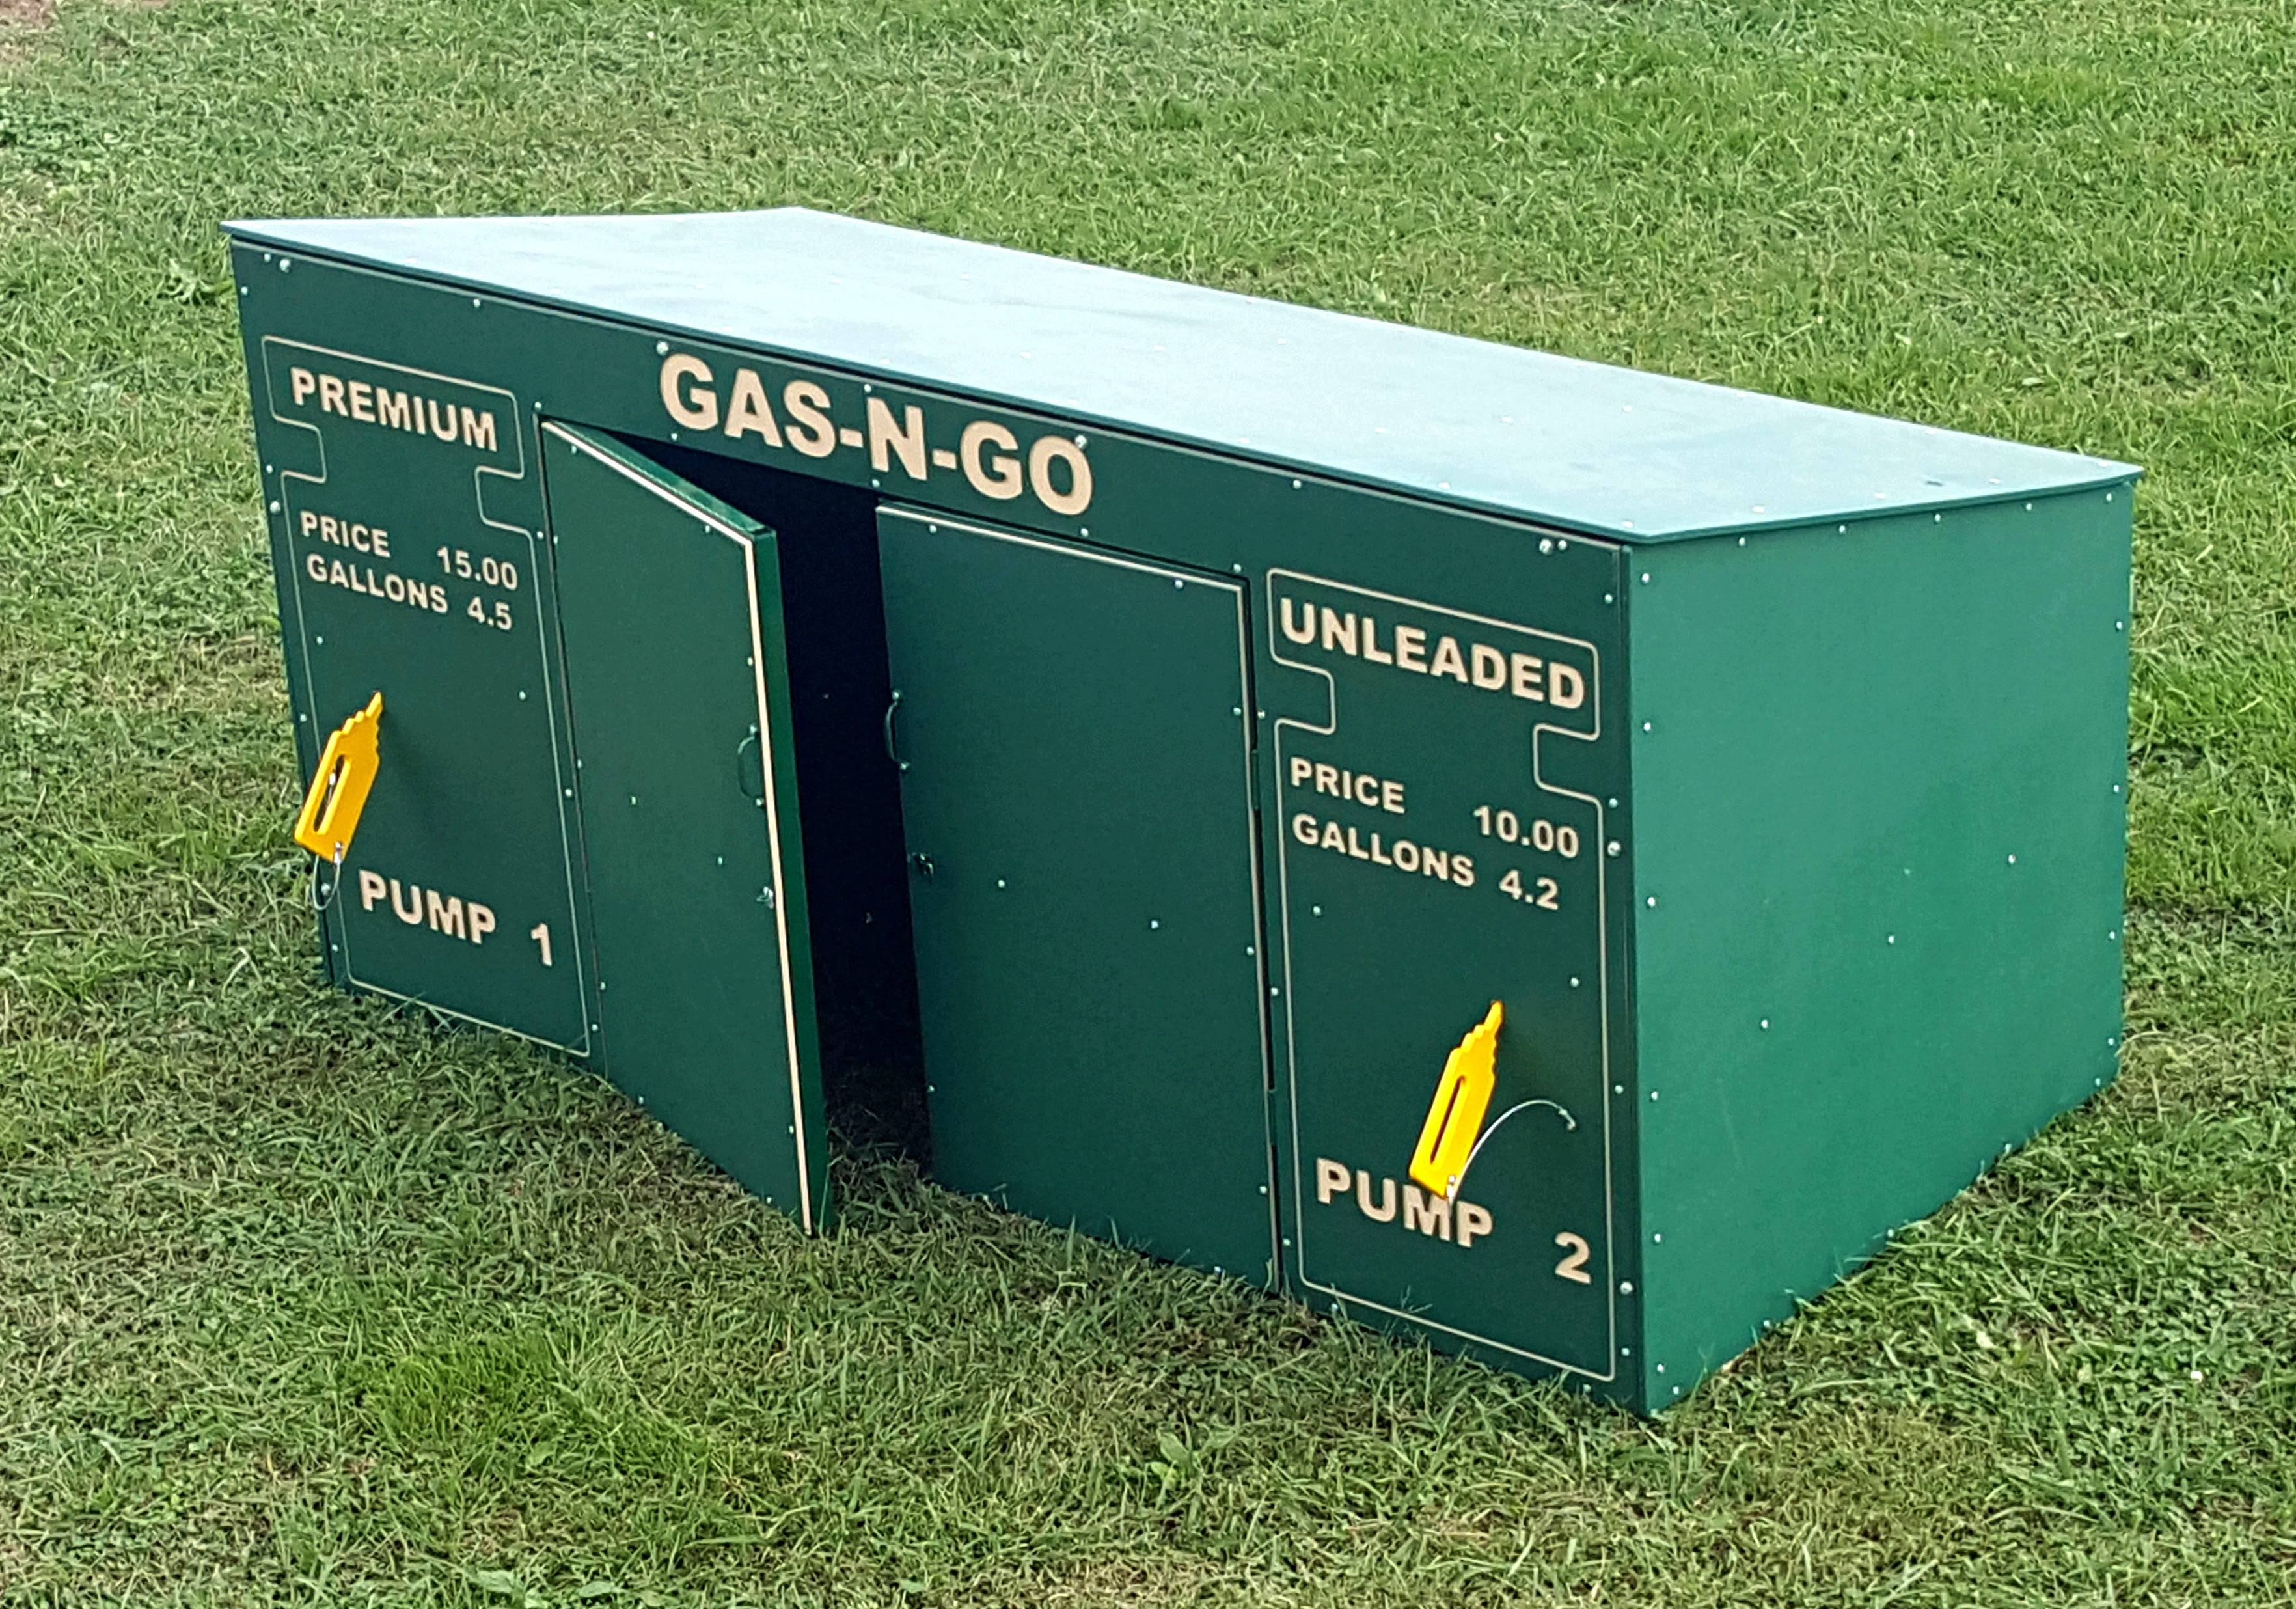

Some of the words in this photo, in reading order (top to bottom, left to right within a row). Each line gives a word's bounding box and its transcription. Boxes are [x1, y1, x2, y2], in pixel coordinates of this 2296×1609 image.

[290, 366, 497, 450] PREMIUM
[659, 355, 1093, 516] GAS-N-GO
[301, 510, 390, 558] PRICE
[437, 546, 517, 591] 15.00
[307, 552, 449, 613] GALLONS
[468, 596, 512, 629] 4.5
[1280, 597, 1585, 708] UNLEADED
[1291, 758, 1404, 814] PRICE
[1472, 805, 1580, 859] 10.00
[1294, 813, 1476, 886] GALLONS
[1500, 870, 1559, 910] 4.2
[360, 870, 495, 944] PUMP
[531, 923, 553, 967] 1
[1317, 1157, 1493, 1248] PUMP
[1555, 1232, 1591, 1284] 2
